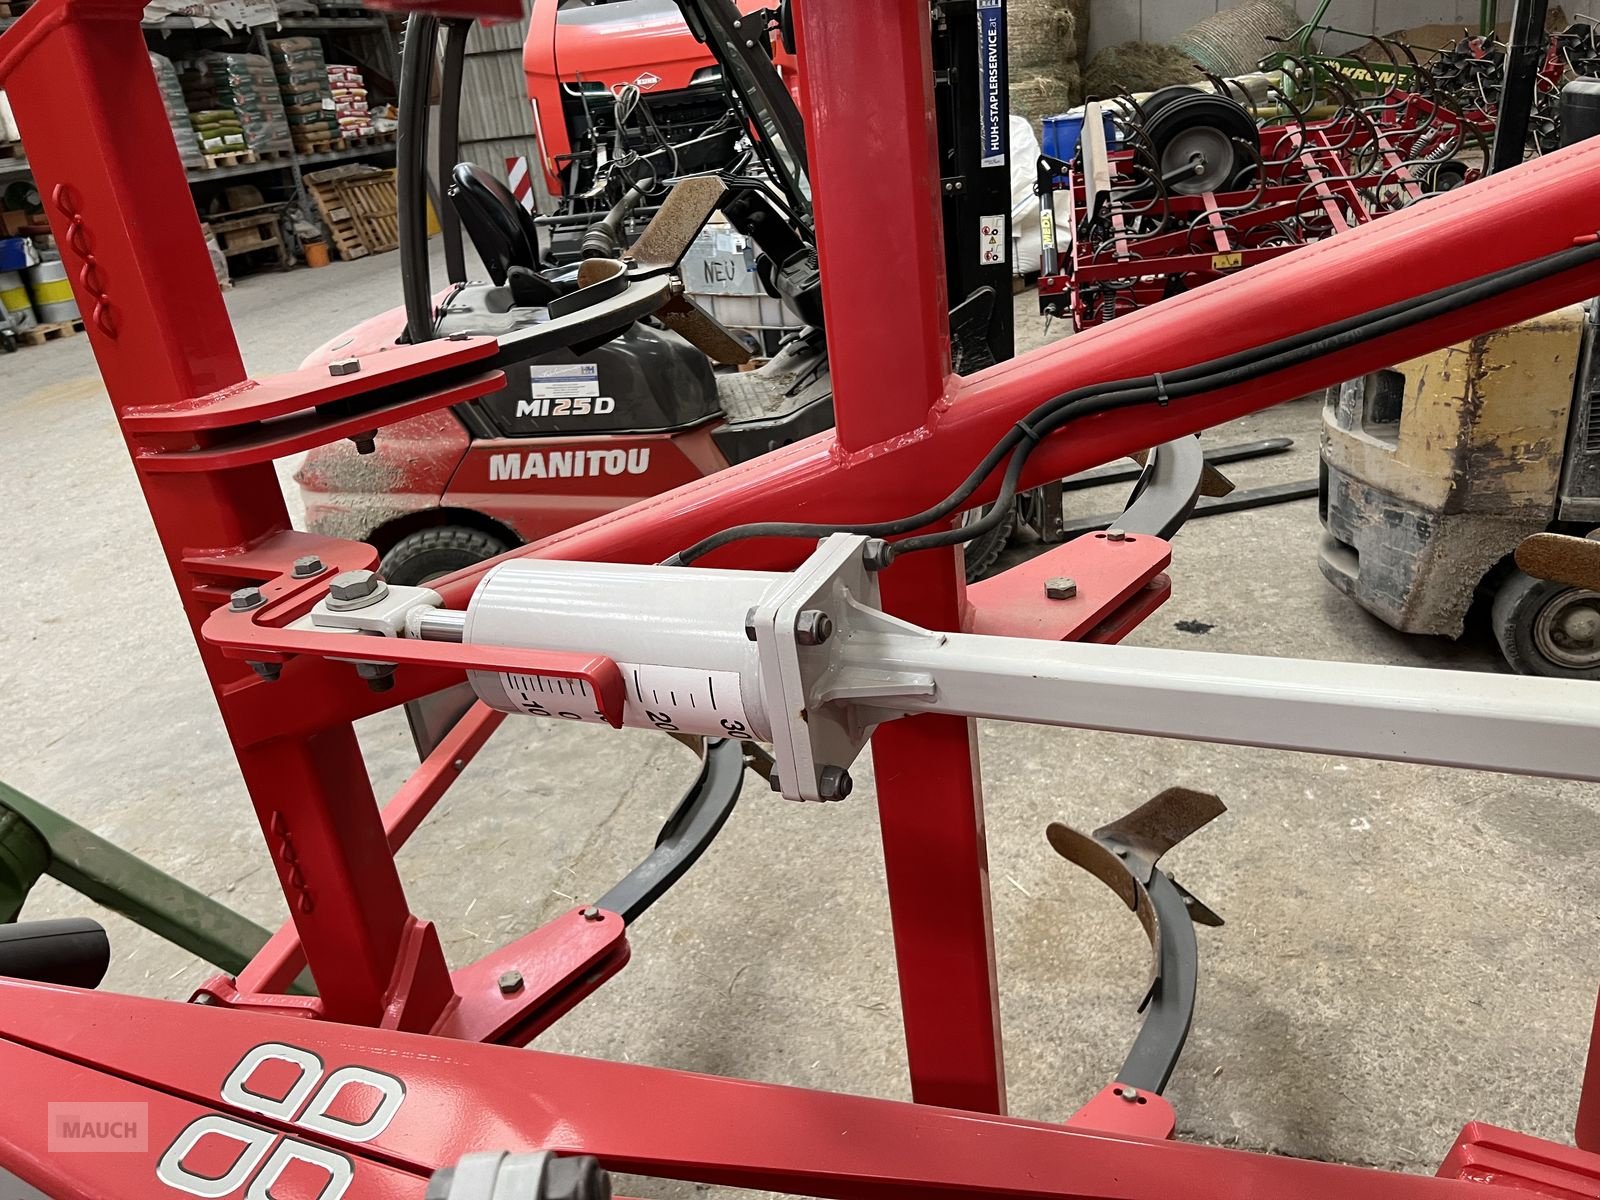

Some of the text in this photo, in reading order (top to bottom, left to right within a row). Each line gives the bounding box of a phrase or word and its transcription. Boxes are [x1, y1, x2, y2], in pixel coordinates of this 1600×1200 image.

[988, 17, 999, 151] HUH-STAPLERSERVICE.at
[704, 260, 735, 283] NEU
[489, 448, 650, 481] MANITOU
[521, 692, 552, 717] -10
[558, 712, 582, 720] 0
[645, 710, 679, 731] 20
[720, 718, 753, 739] 30
